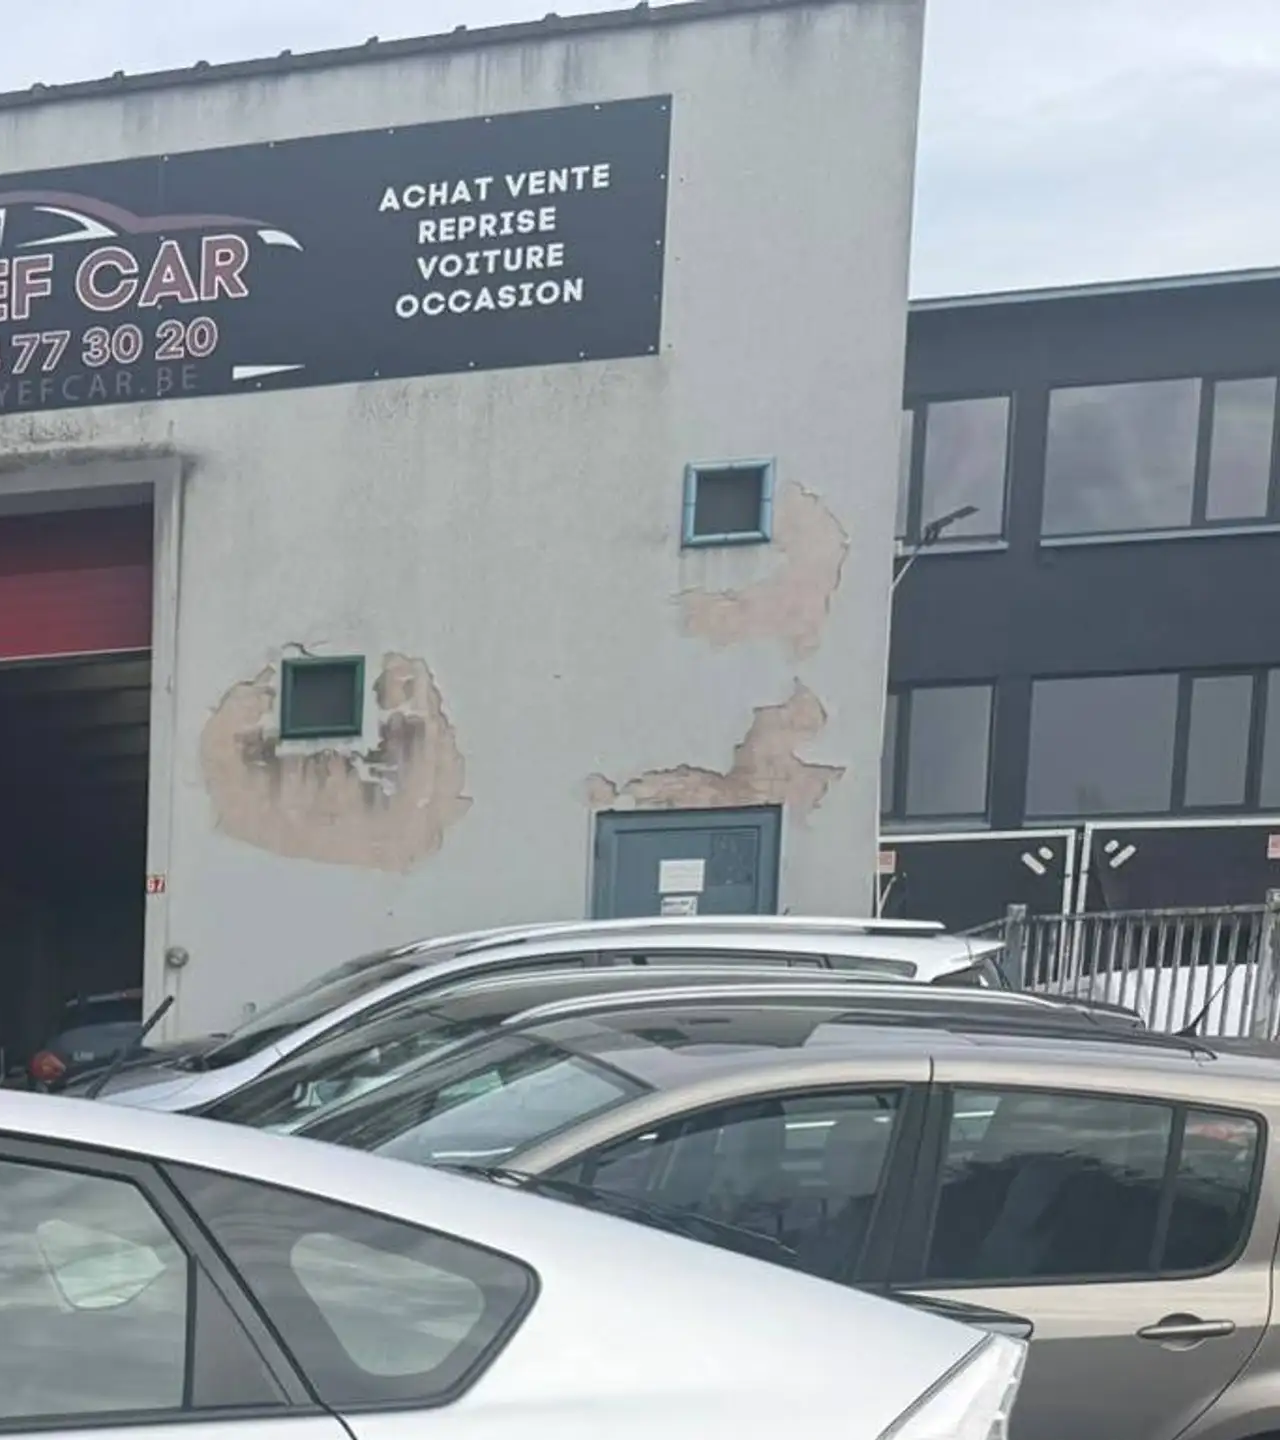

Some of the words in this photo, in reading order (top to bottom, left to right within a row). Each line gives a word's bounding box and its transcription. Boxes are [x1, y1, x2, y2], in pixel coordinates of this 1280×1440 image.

[378, 176, 494, 212] ACHAT
[505, 164, 612, 198] VENTE
[418, 206, 557, 244] REPRISE
[76, 234, 249, 312] CAR
[416, 243, 565, 280] VOITURE
[394, 278, 584, 319] OCCASION
[11, 330, 71, 374] 77
[82, 323, 143, 368] 30
[155, 316, 218, 361] 20
